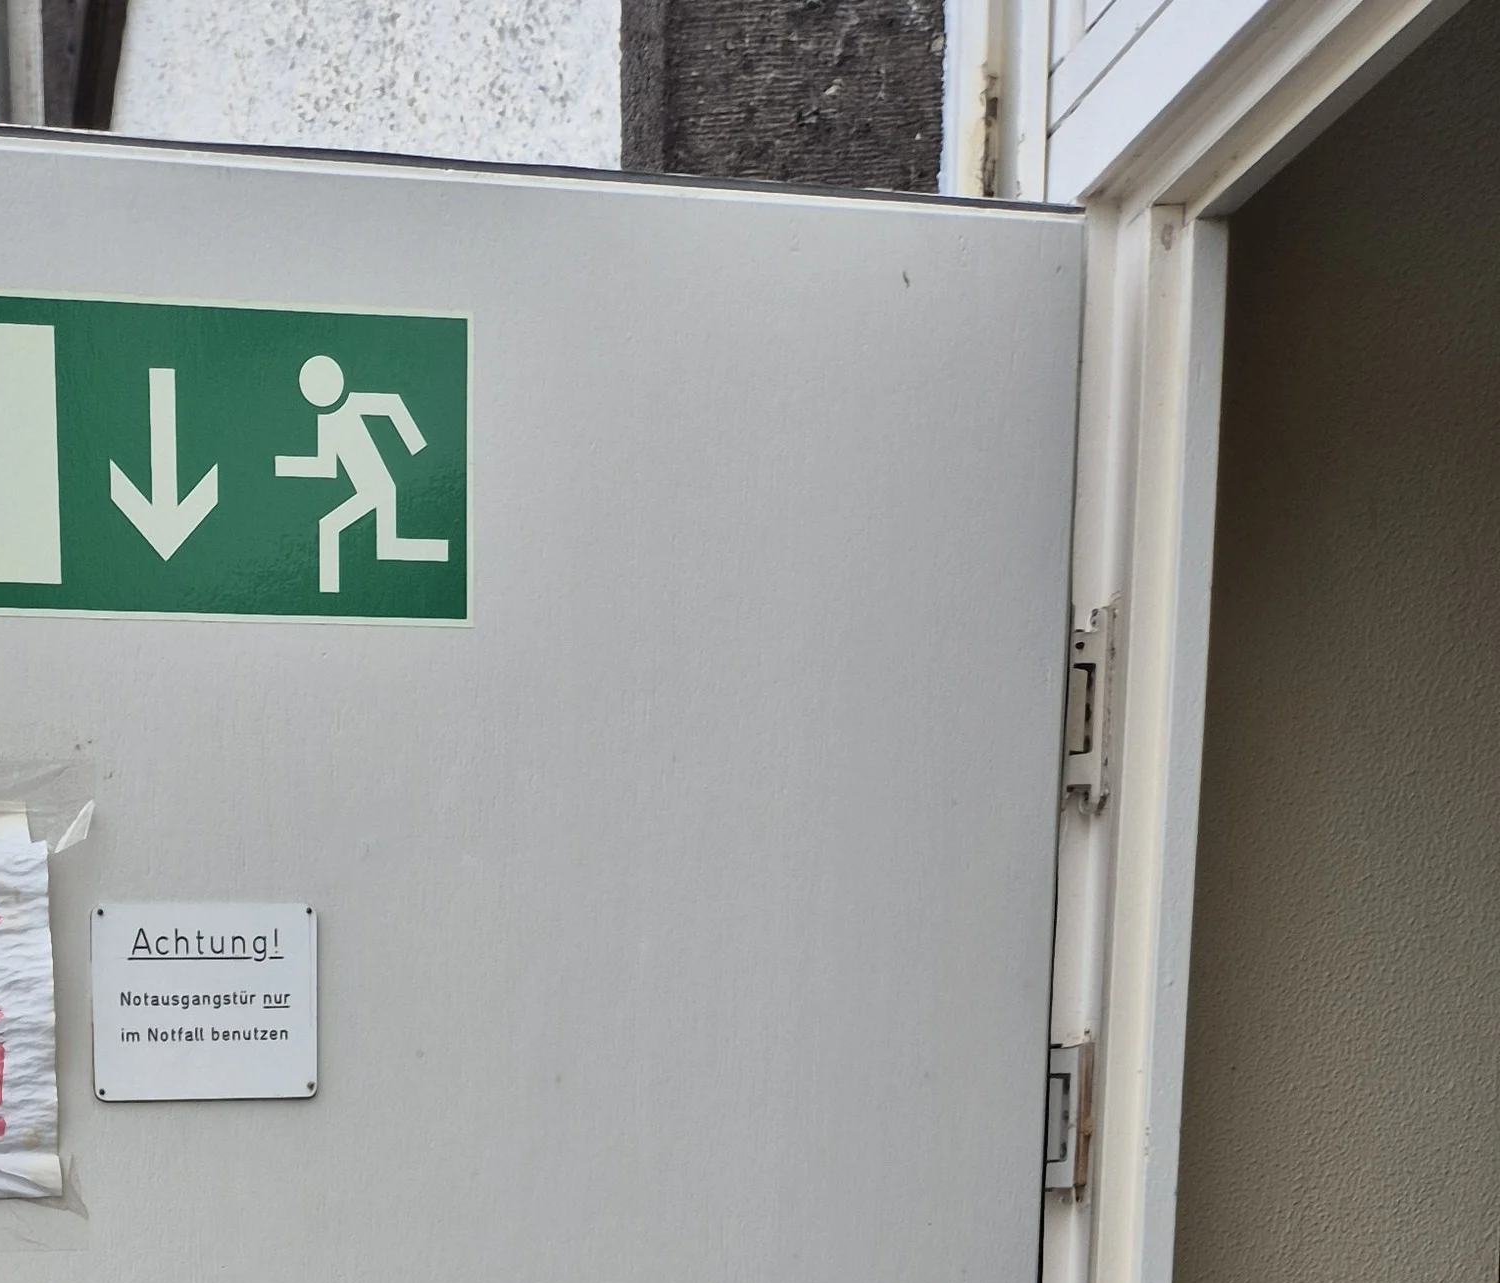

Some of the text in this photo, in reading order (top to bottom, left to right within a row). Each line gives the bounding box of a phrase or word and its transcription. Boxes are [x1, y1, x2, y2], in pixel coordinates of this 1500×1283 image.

[131, 927, 279, 962] Achtung!
[119, 990, 291, 1009] Notausgangstür nur
[121, 1027, 289, 1042] im Notfall benutzen
